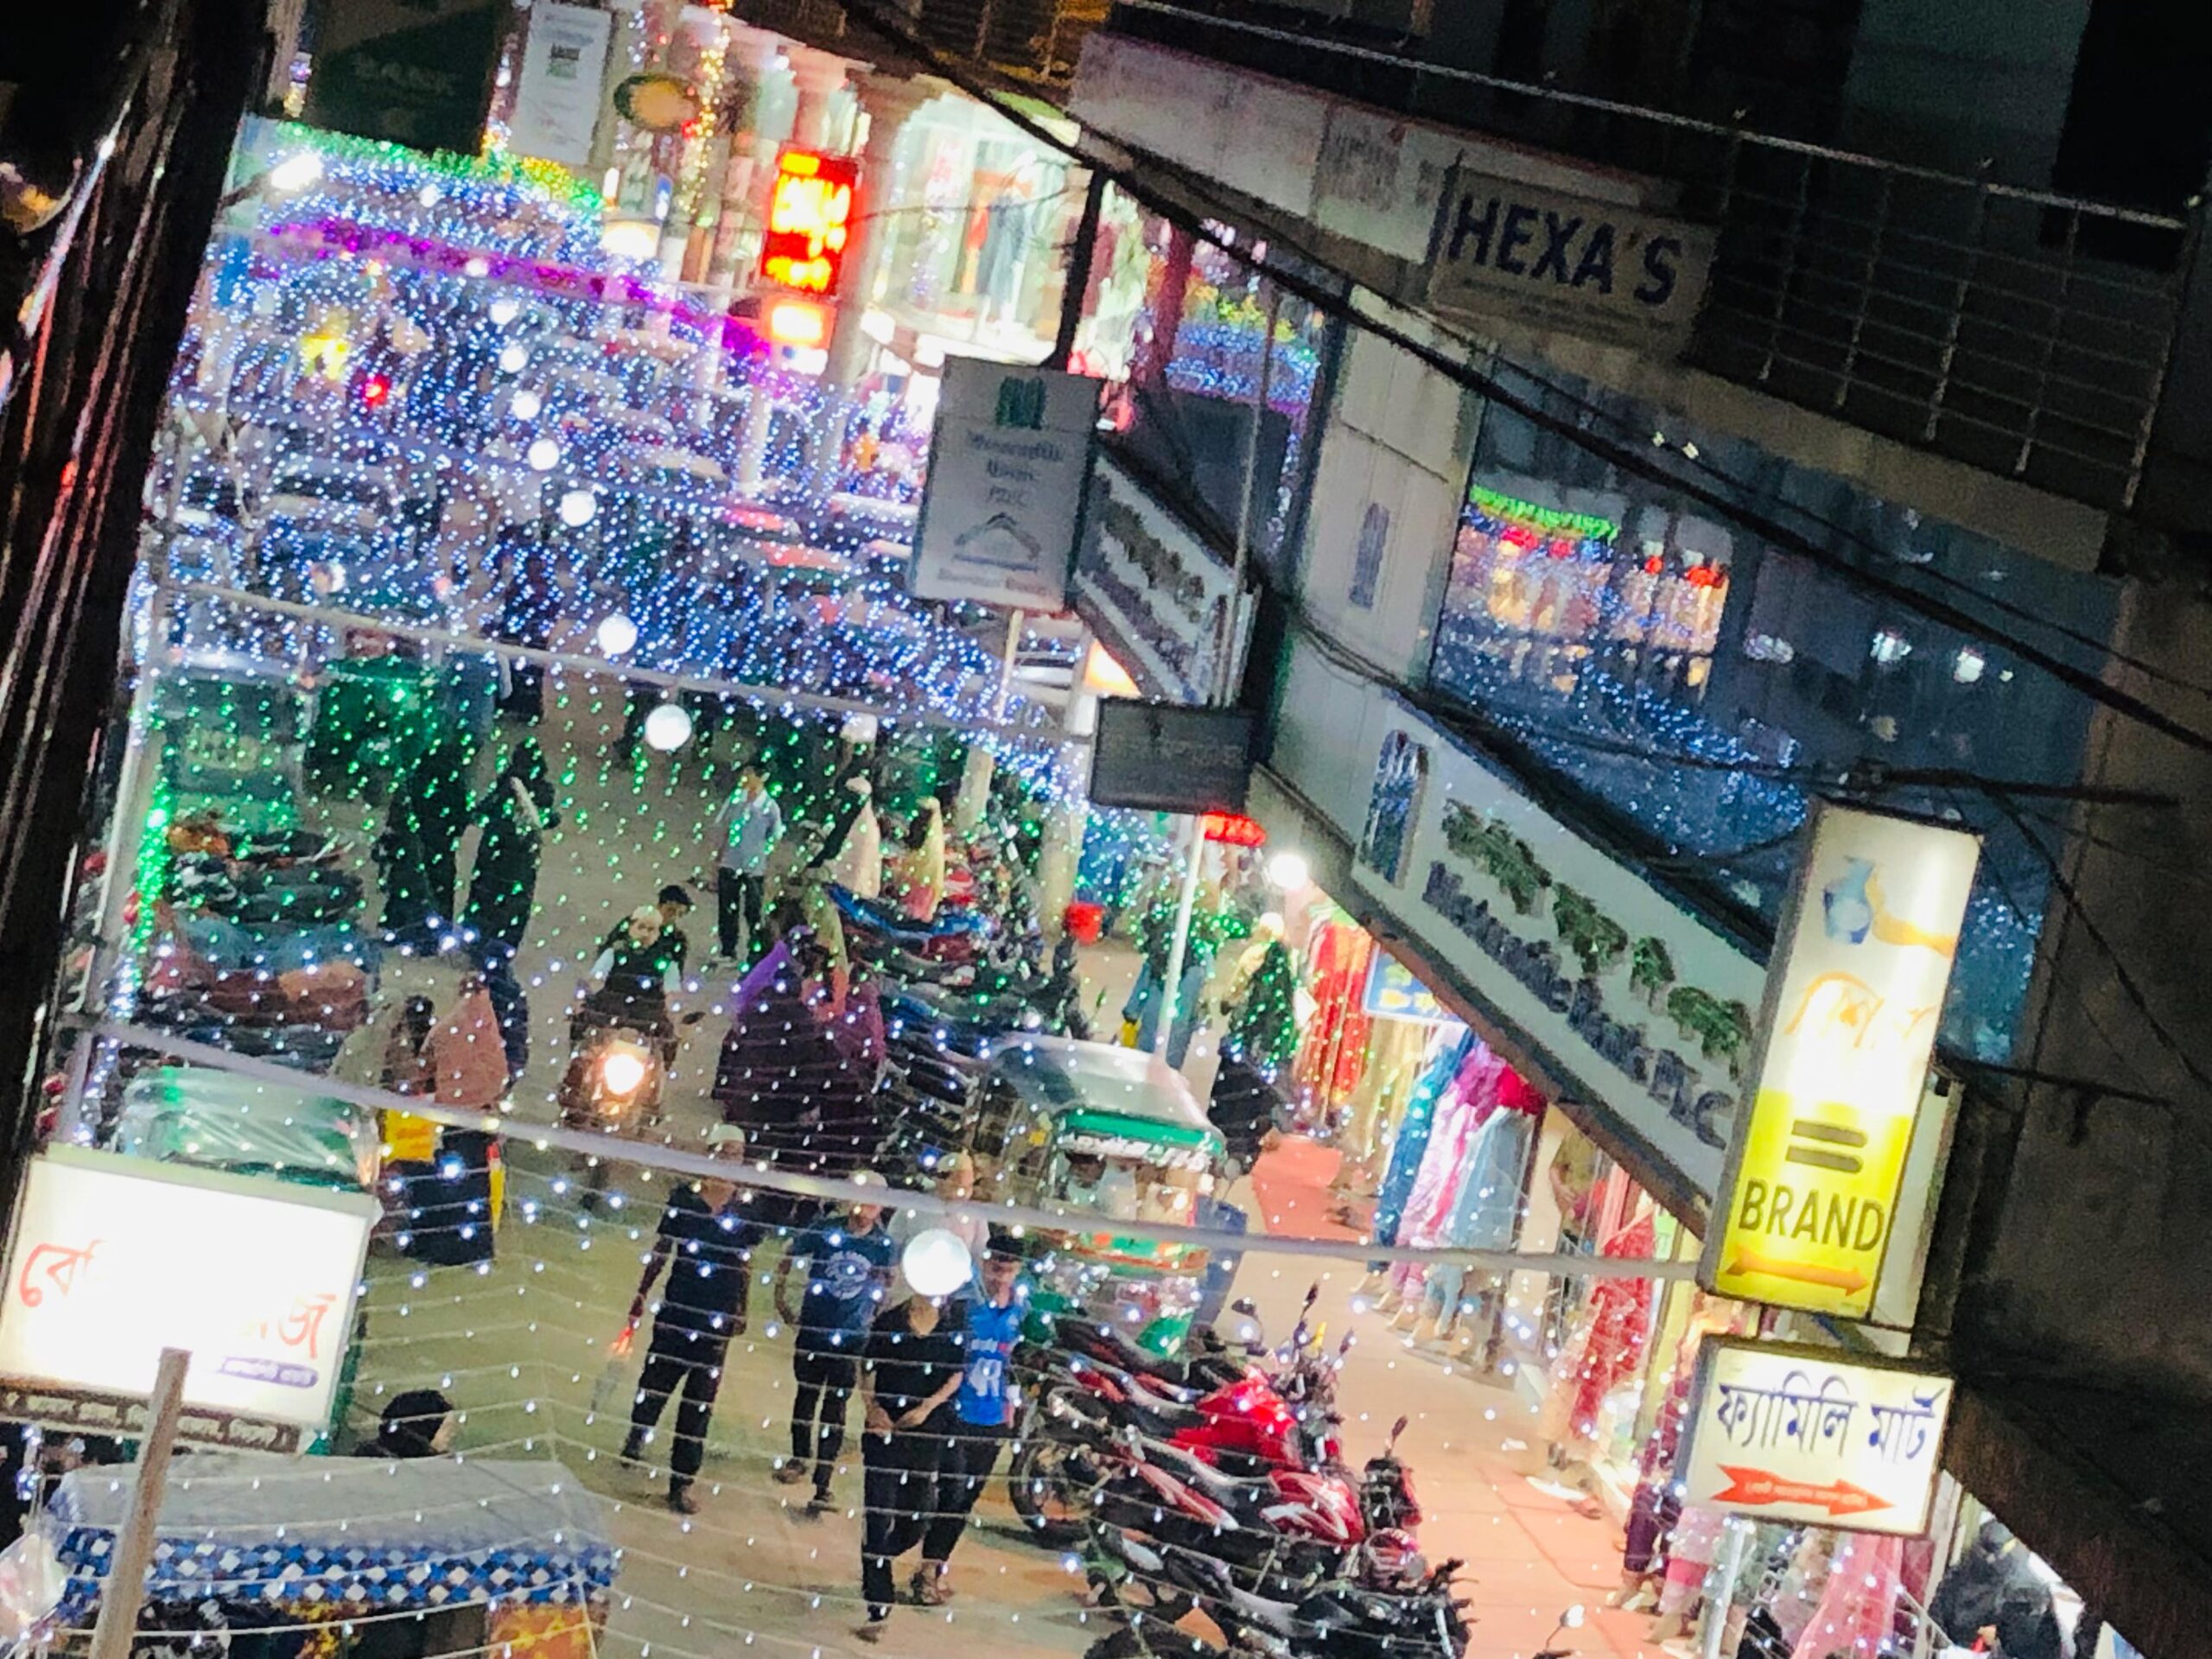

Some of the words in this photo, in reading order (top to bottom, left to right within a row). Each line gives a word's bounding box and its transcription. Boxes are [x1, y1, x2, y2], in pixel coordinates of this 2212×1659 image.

[1447, 194, 1682, 305] HEXA'S
[1738, 1177, 1885, 1251] BRAND
[1717, 1370, 1858, 1458] ফ্যামিলি
[1868, 1387, 1945, 1463] মার্ট
